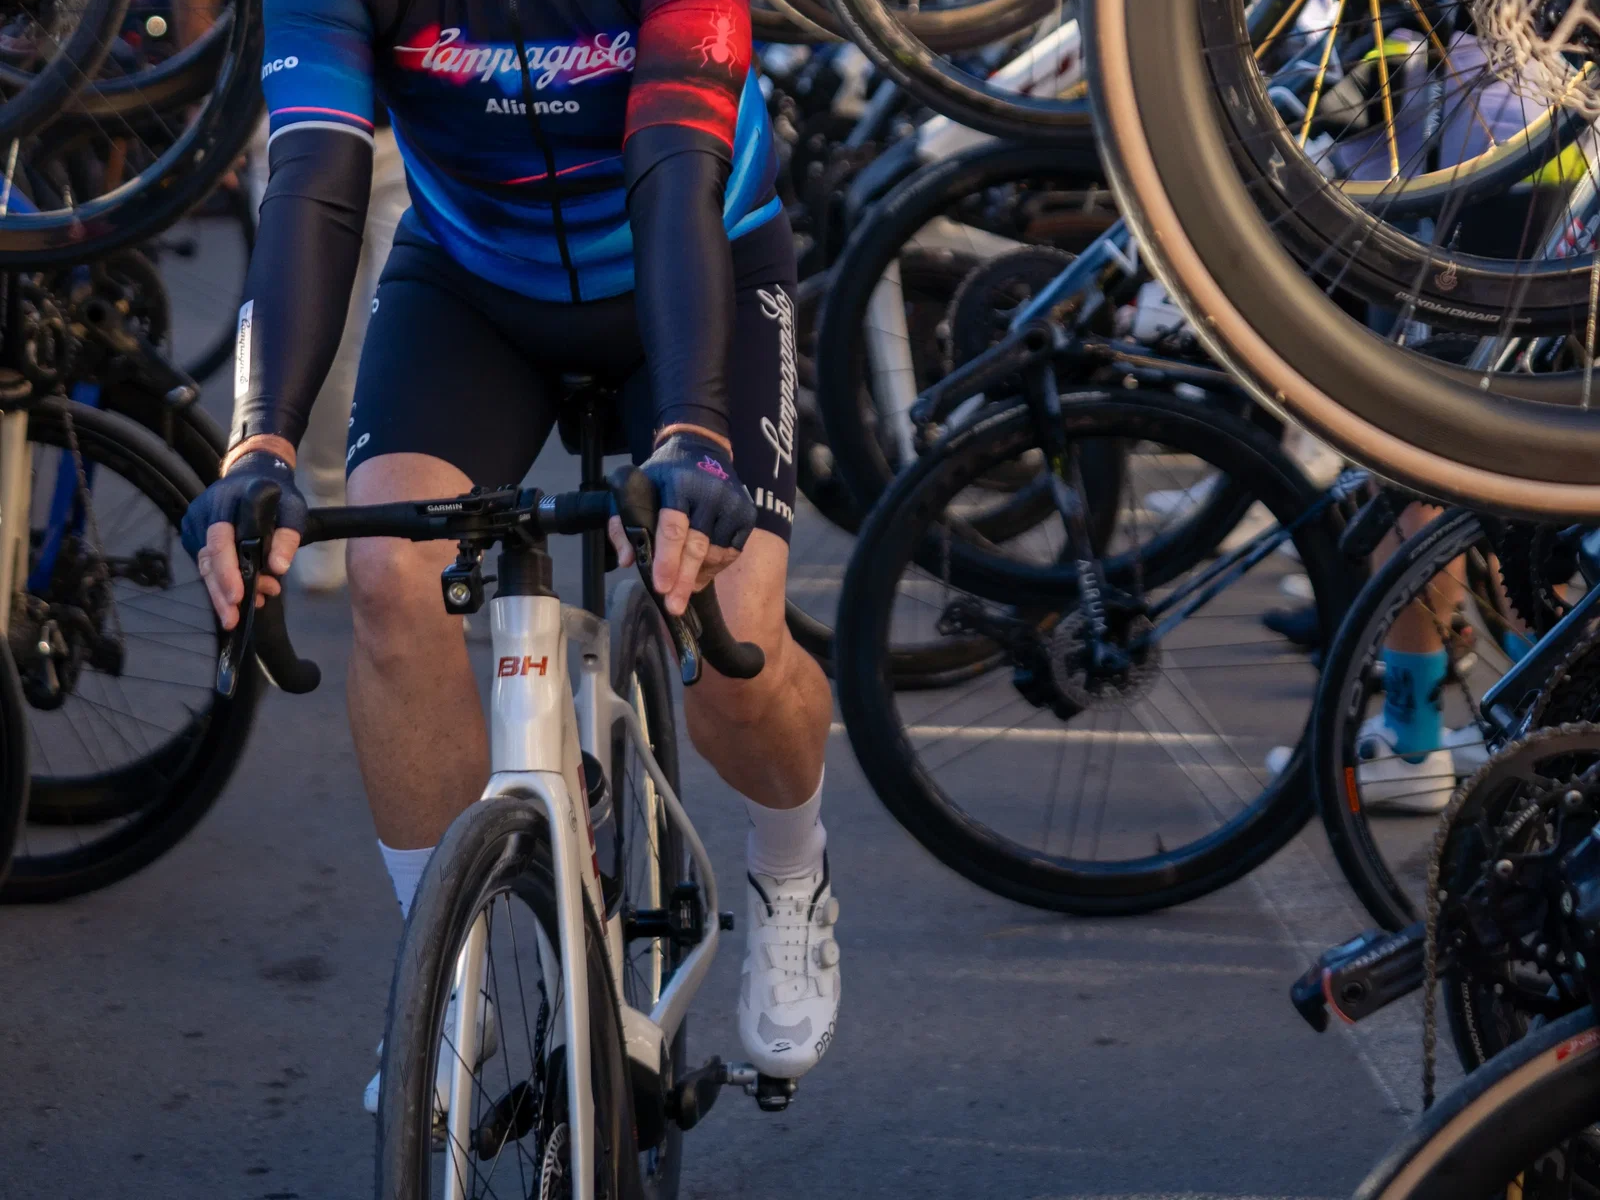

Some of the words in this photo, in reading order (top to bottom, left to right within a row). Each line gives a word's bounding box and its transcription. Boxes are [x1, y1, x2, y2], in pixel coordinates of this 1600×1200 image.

[393, 28, 636, 90] Campagnolo
[756, 284, 799, 479] Campagnolo
[427, 502, 463, 512] GARMIN
[497, 655, 549, 678] BH
